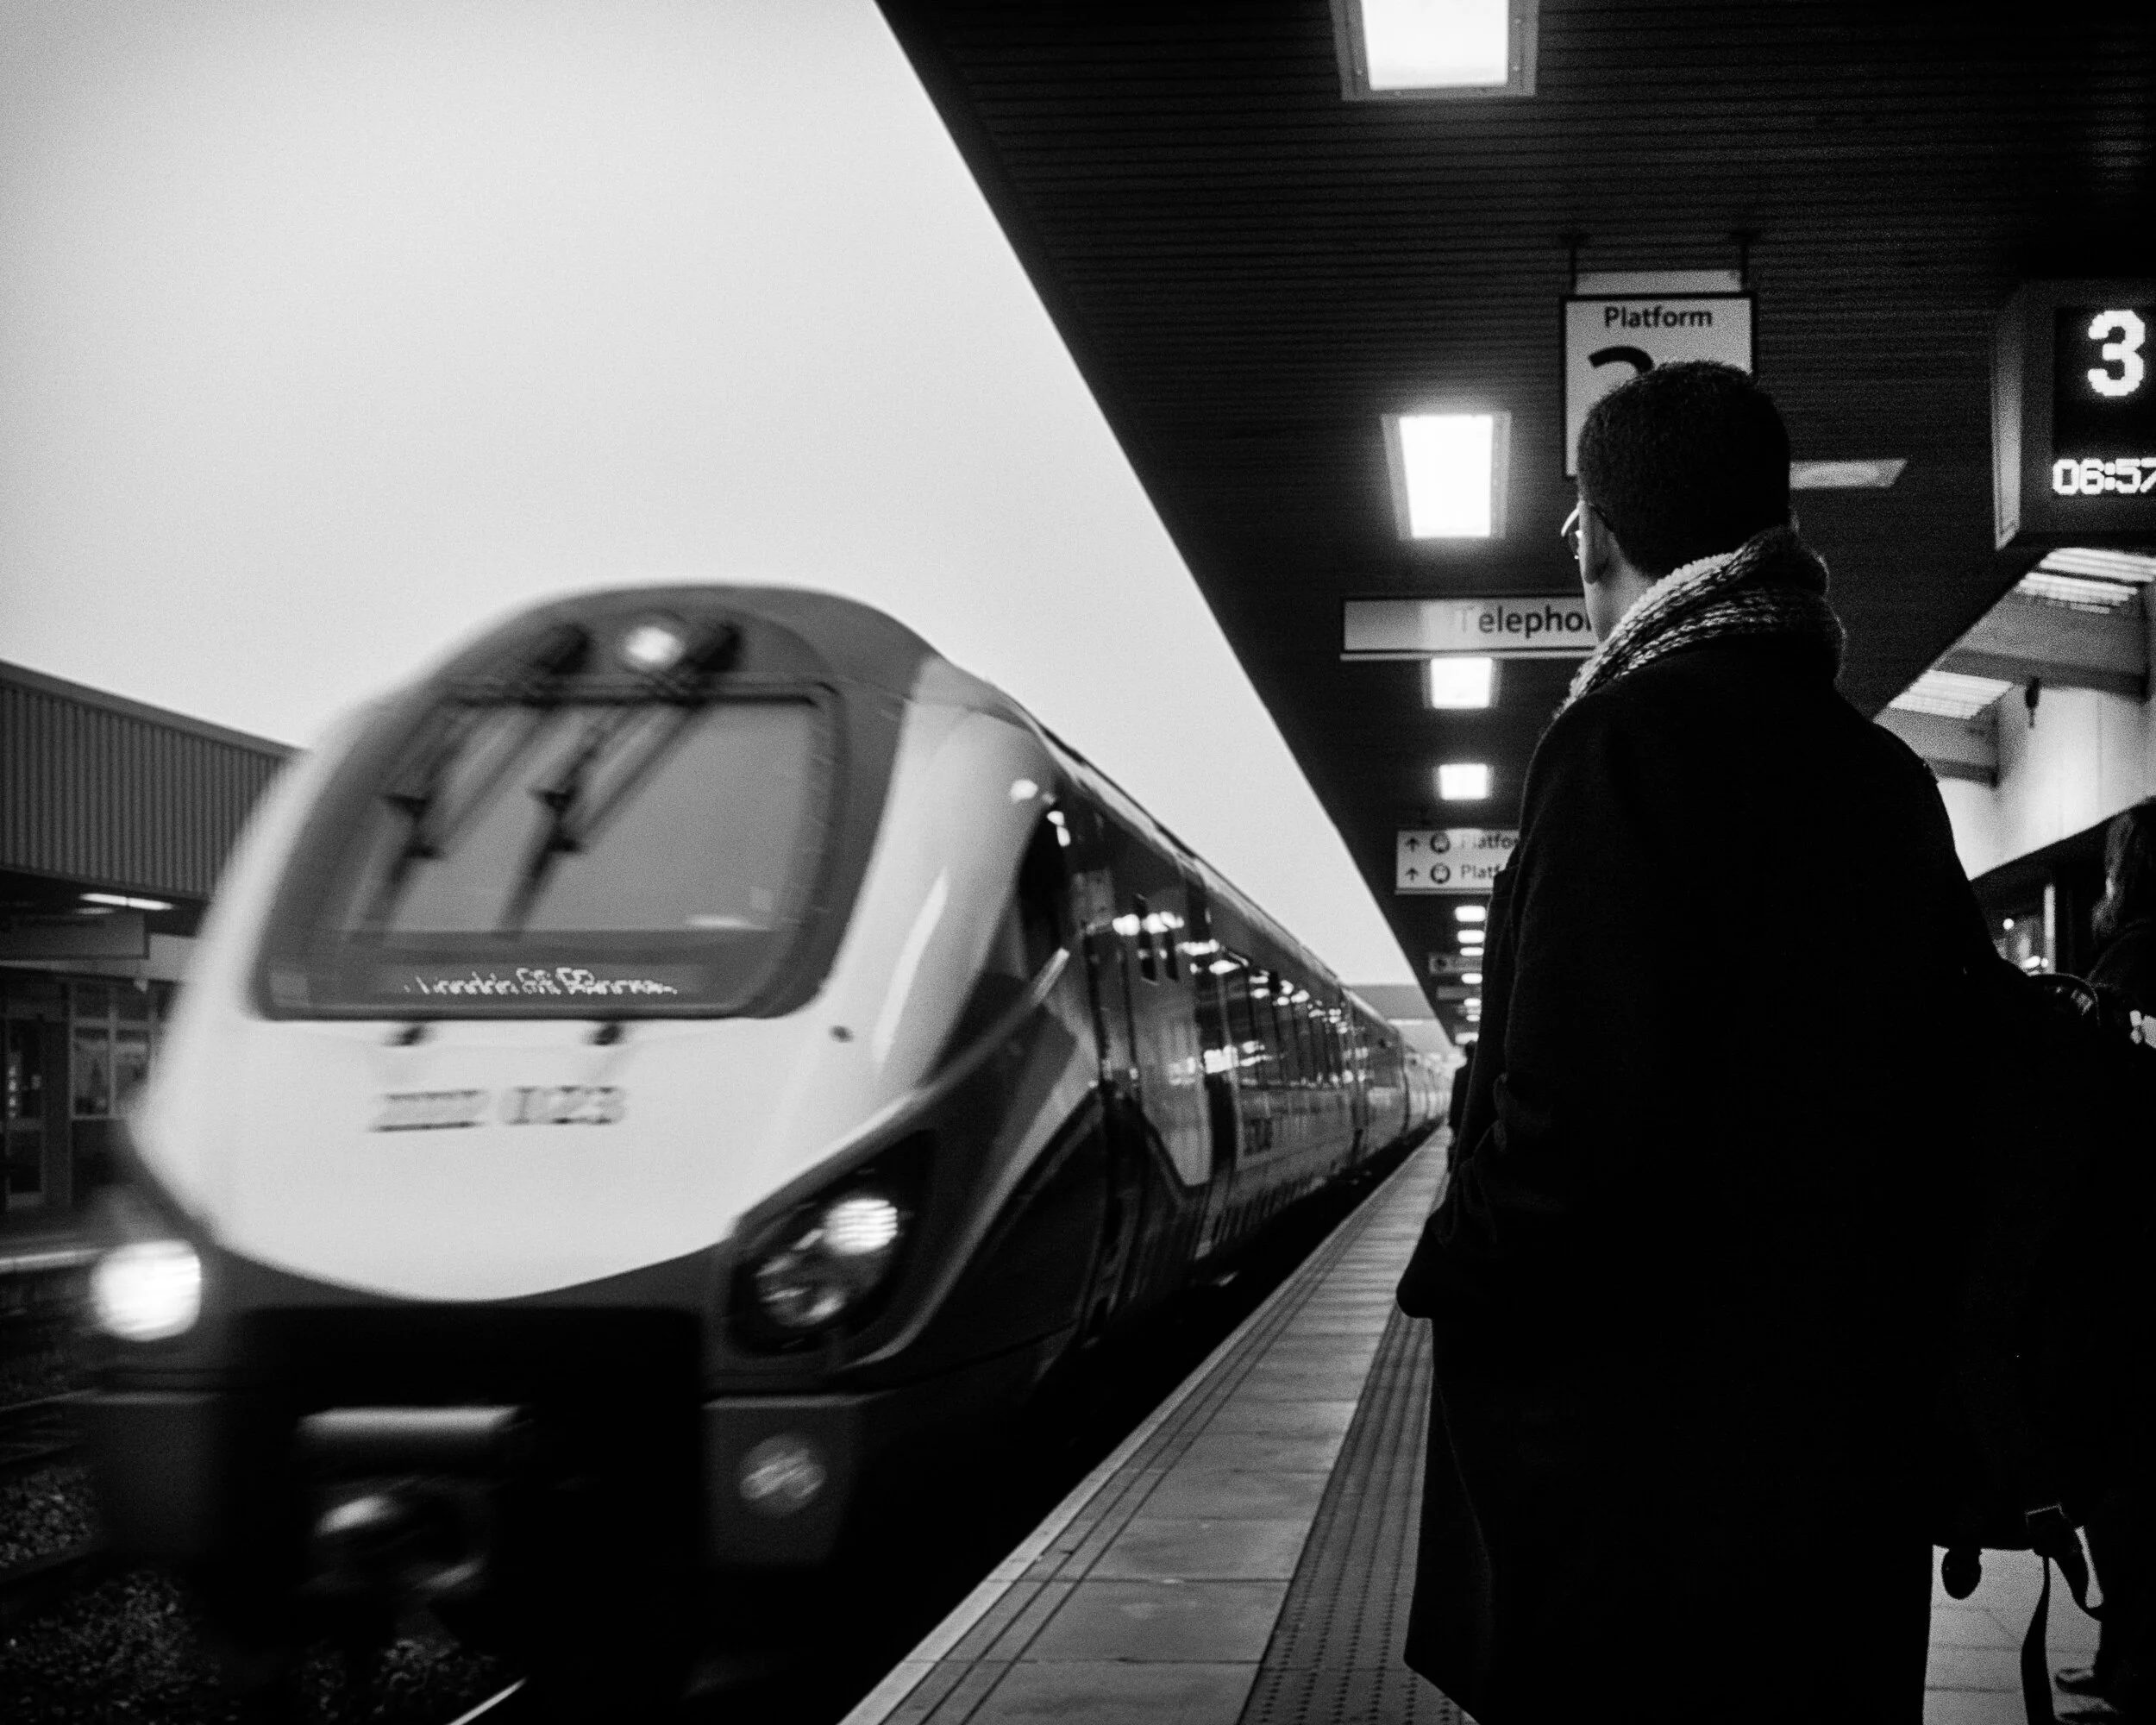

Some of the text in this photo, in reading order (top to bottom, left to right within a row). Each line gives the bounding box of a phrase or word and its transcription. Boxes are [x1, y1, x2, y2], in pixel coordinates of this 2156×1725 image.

[1604, 305, 1713, 329] Platform
[2087, 310, 2145, 397] 3
[2053, 458, 2156, 495] 06:57
